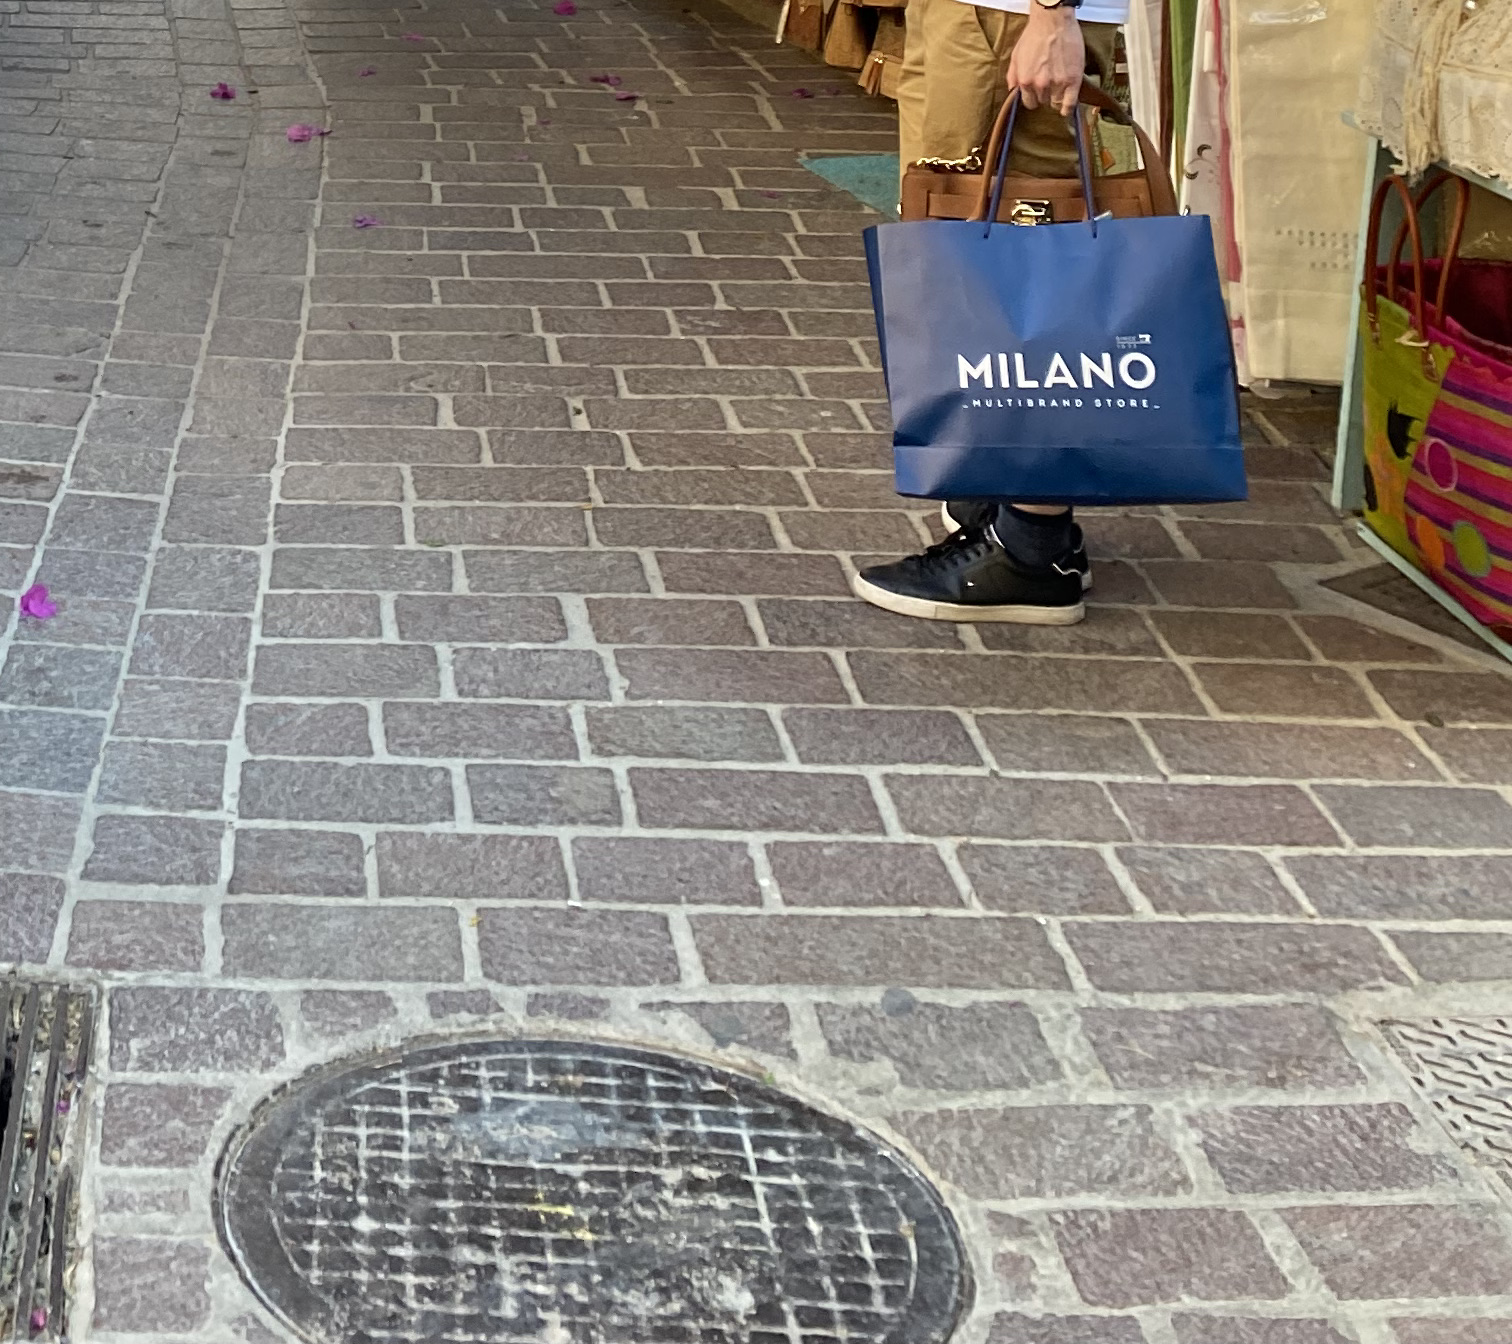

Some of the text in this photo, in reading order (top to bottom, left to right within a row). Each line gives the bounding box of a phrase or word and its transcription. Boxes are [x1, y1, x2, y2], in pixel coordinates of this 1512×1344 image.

[957, 352, 1157, 389] MILANO
[972, 398, 1150, 409] MULTIBRAND STORE
